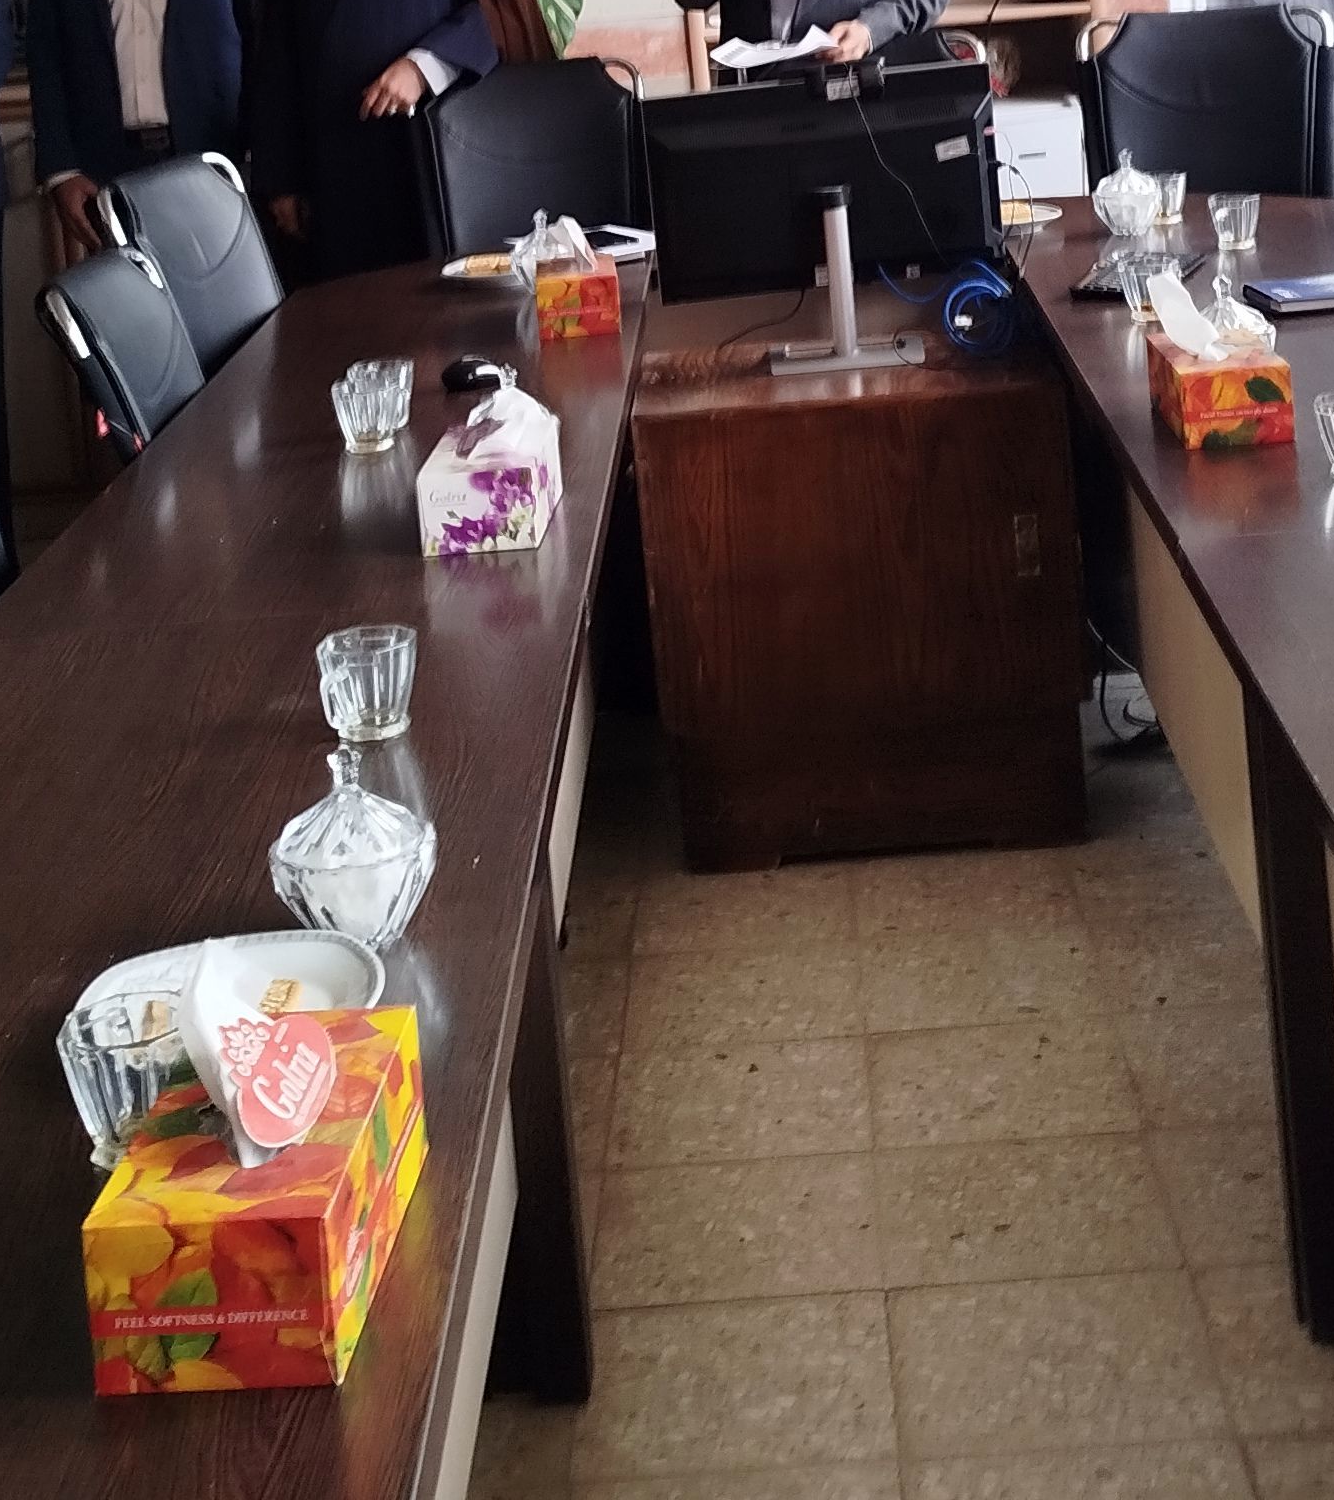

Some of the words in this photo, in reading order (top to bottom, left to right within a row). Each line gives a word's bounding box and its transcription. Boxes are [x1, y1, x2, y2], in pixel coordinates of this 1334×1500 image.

[115, 1316, 149, 1329] FEEL
[150, 1312, 215, 1328] SOFTNESS
[228, 1308, 309, 1325] DIFFERENCE
